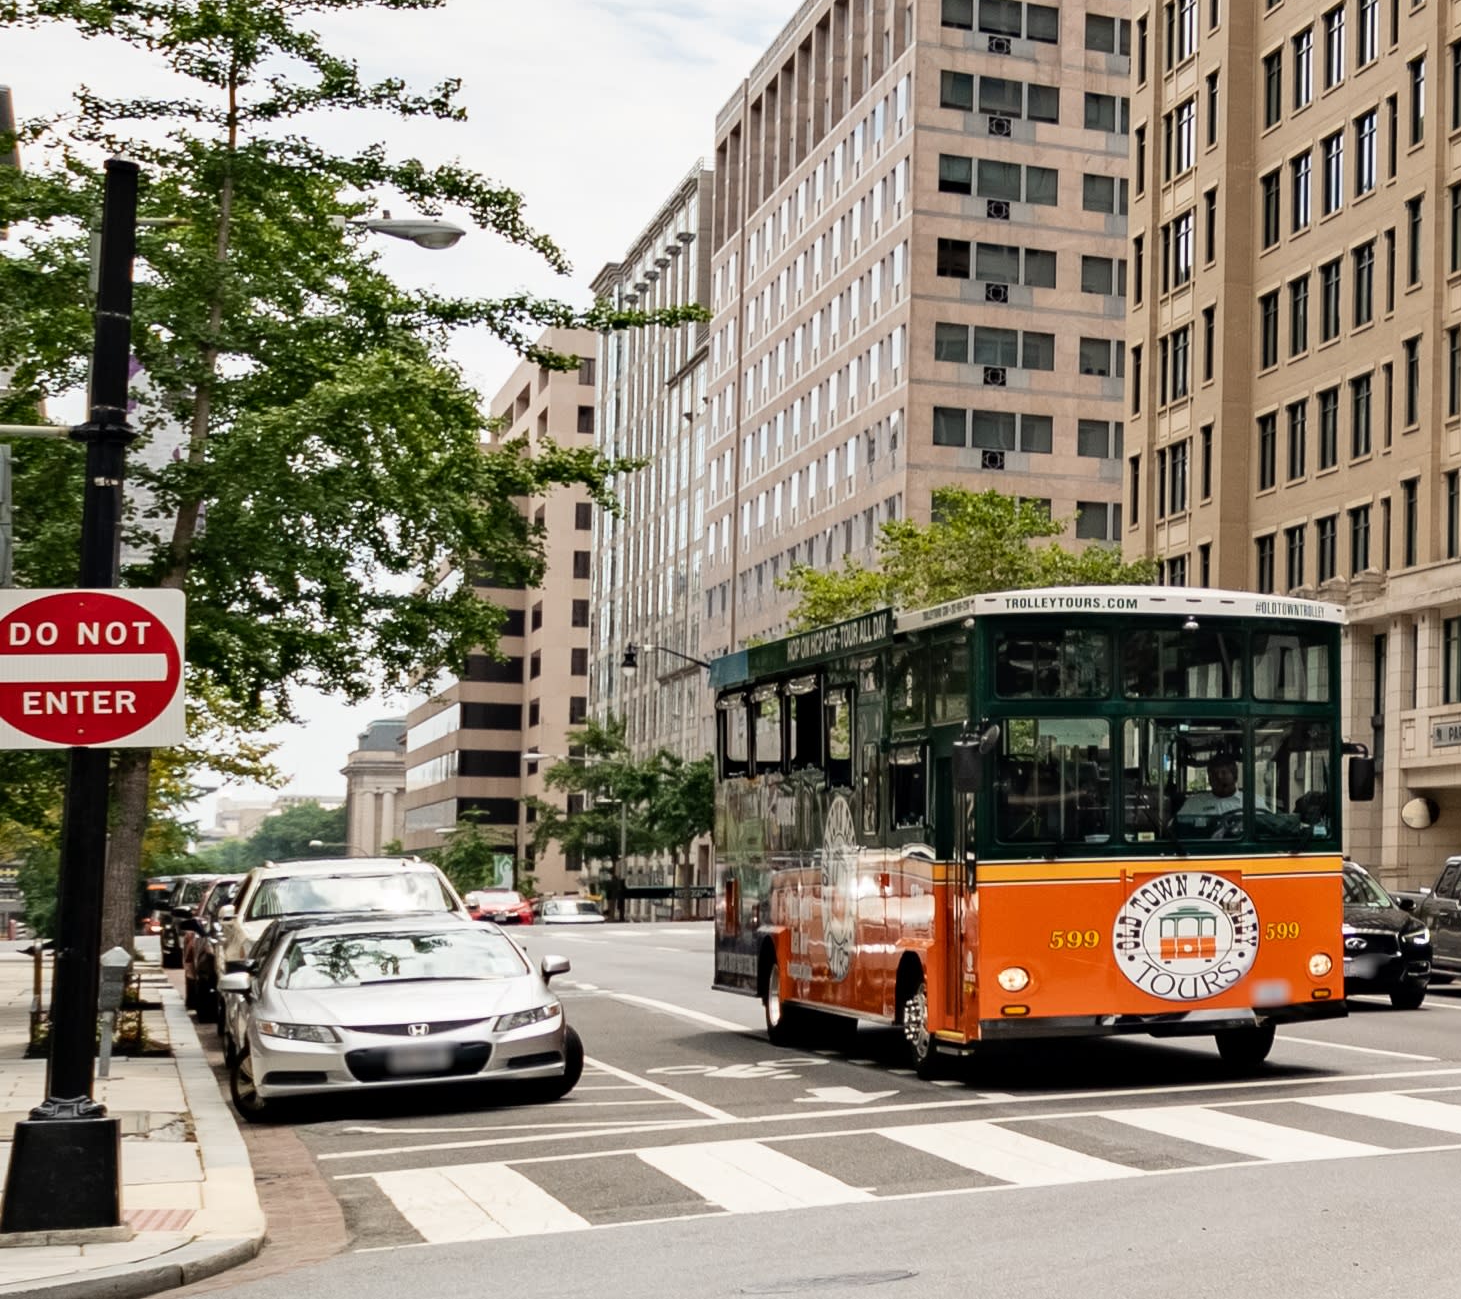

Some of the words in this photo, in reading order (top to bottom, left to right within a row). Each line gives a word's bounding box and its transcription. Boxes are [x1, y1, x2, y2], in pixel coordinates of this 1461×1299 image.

[1005, 597, 1138, 610] TROLLEYTOURS.COM
[1255, 602, 1325, 619] #OLDTOWNTROLLEY
[9, 621, 59, 646] DO
[77, 621, 152, 646] NOT
[787, 638, 800, 662] HOP
[801, 634, 810, 659] ON
[811, 631, 824, 656] HOP
[860, 617, 872, 643] ALL
[873, 613, 887, 641] DAY
[23, 690, 137, 715] ENTER
[1116, 915, 1142, 950] OLD
[1129, 874, 1188, 914] TOWN
[1049, 930, 1101, 949] 599
[1265, 922, 1300, 940] 599
[1135, 960, 1241, 999] TOURS
